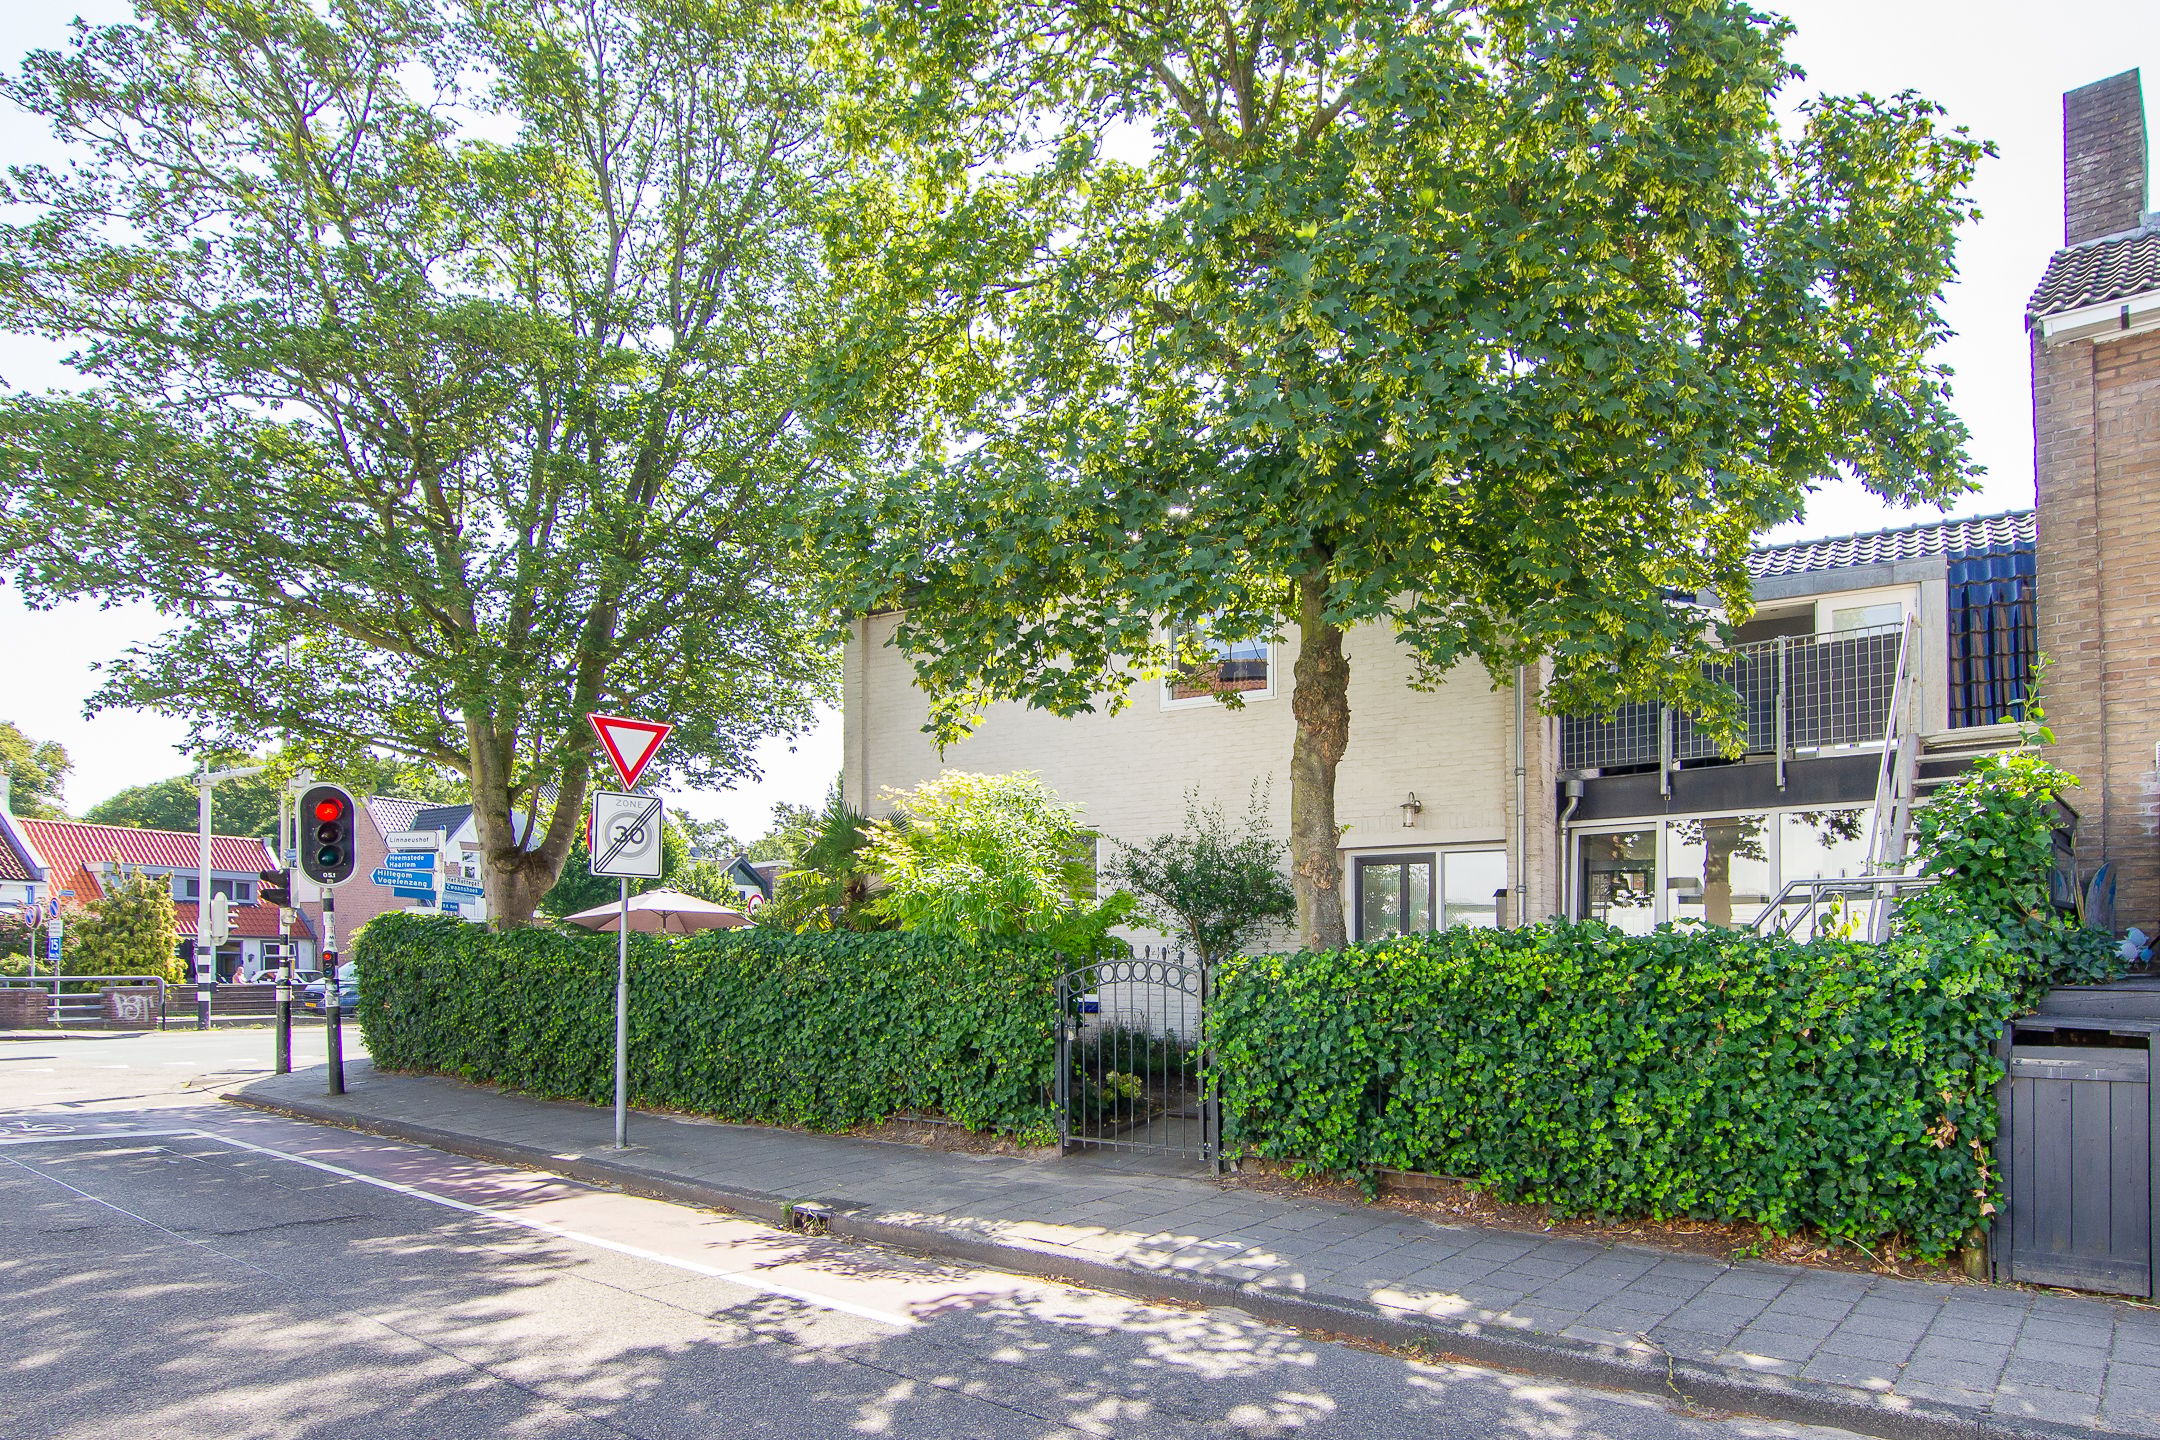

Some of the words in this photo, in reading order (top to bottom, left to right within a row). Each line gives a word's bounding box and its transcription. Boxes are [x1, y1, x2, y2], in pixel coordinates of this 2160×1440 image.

[616, 799, 643, 809] ZONE
[614, 826, 644, 845] 30
[377, 869, 413, 878] Hillegom
[377, 877, 428, 888] Vogelenzang
[51, 939, 59, 951] 15
